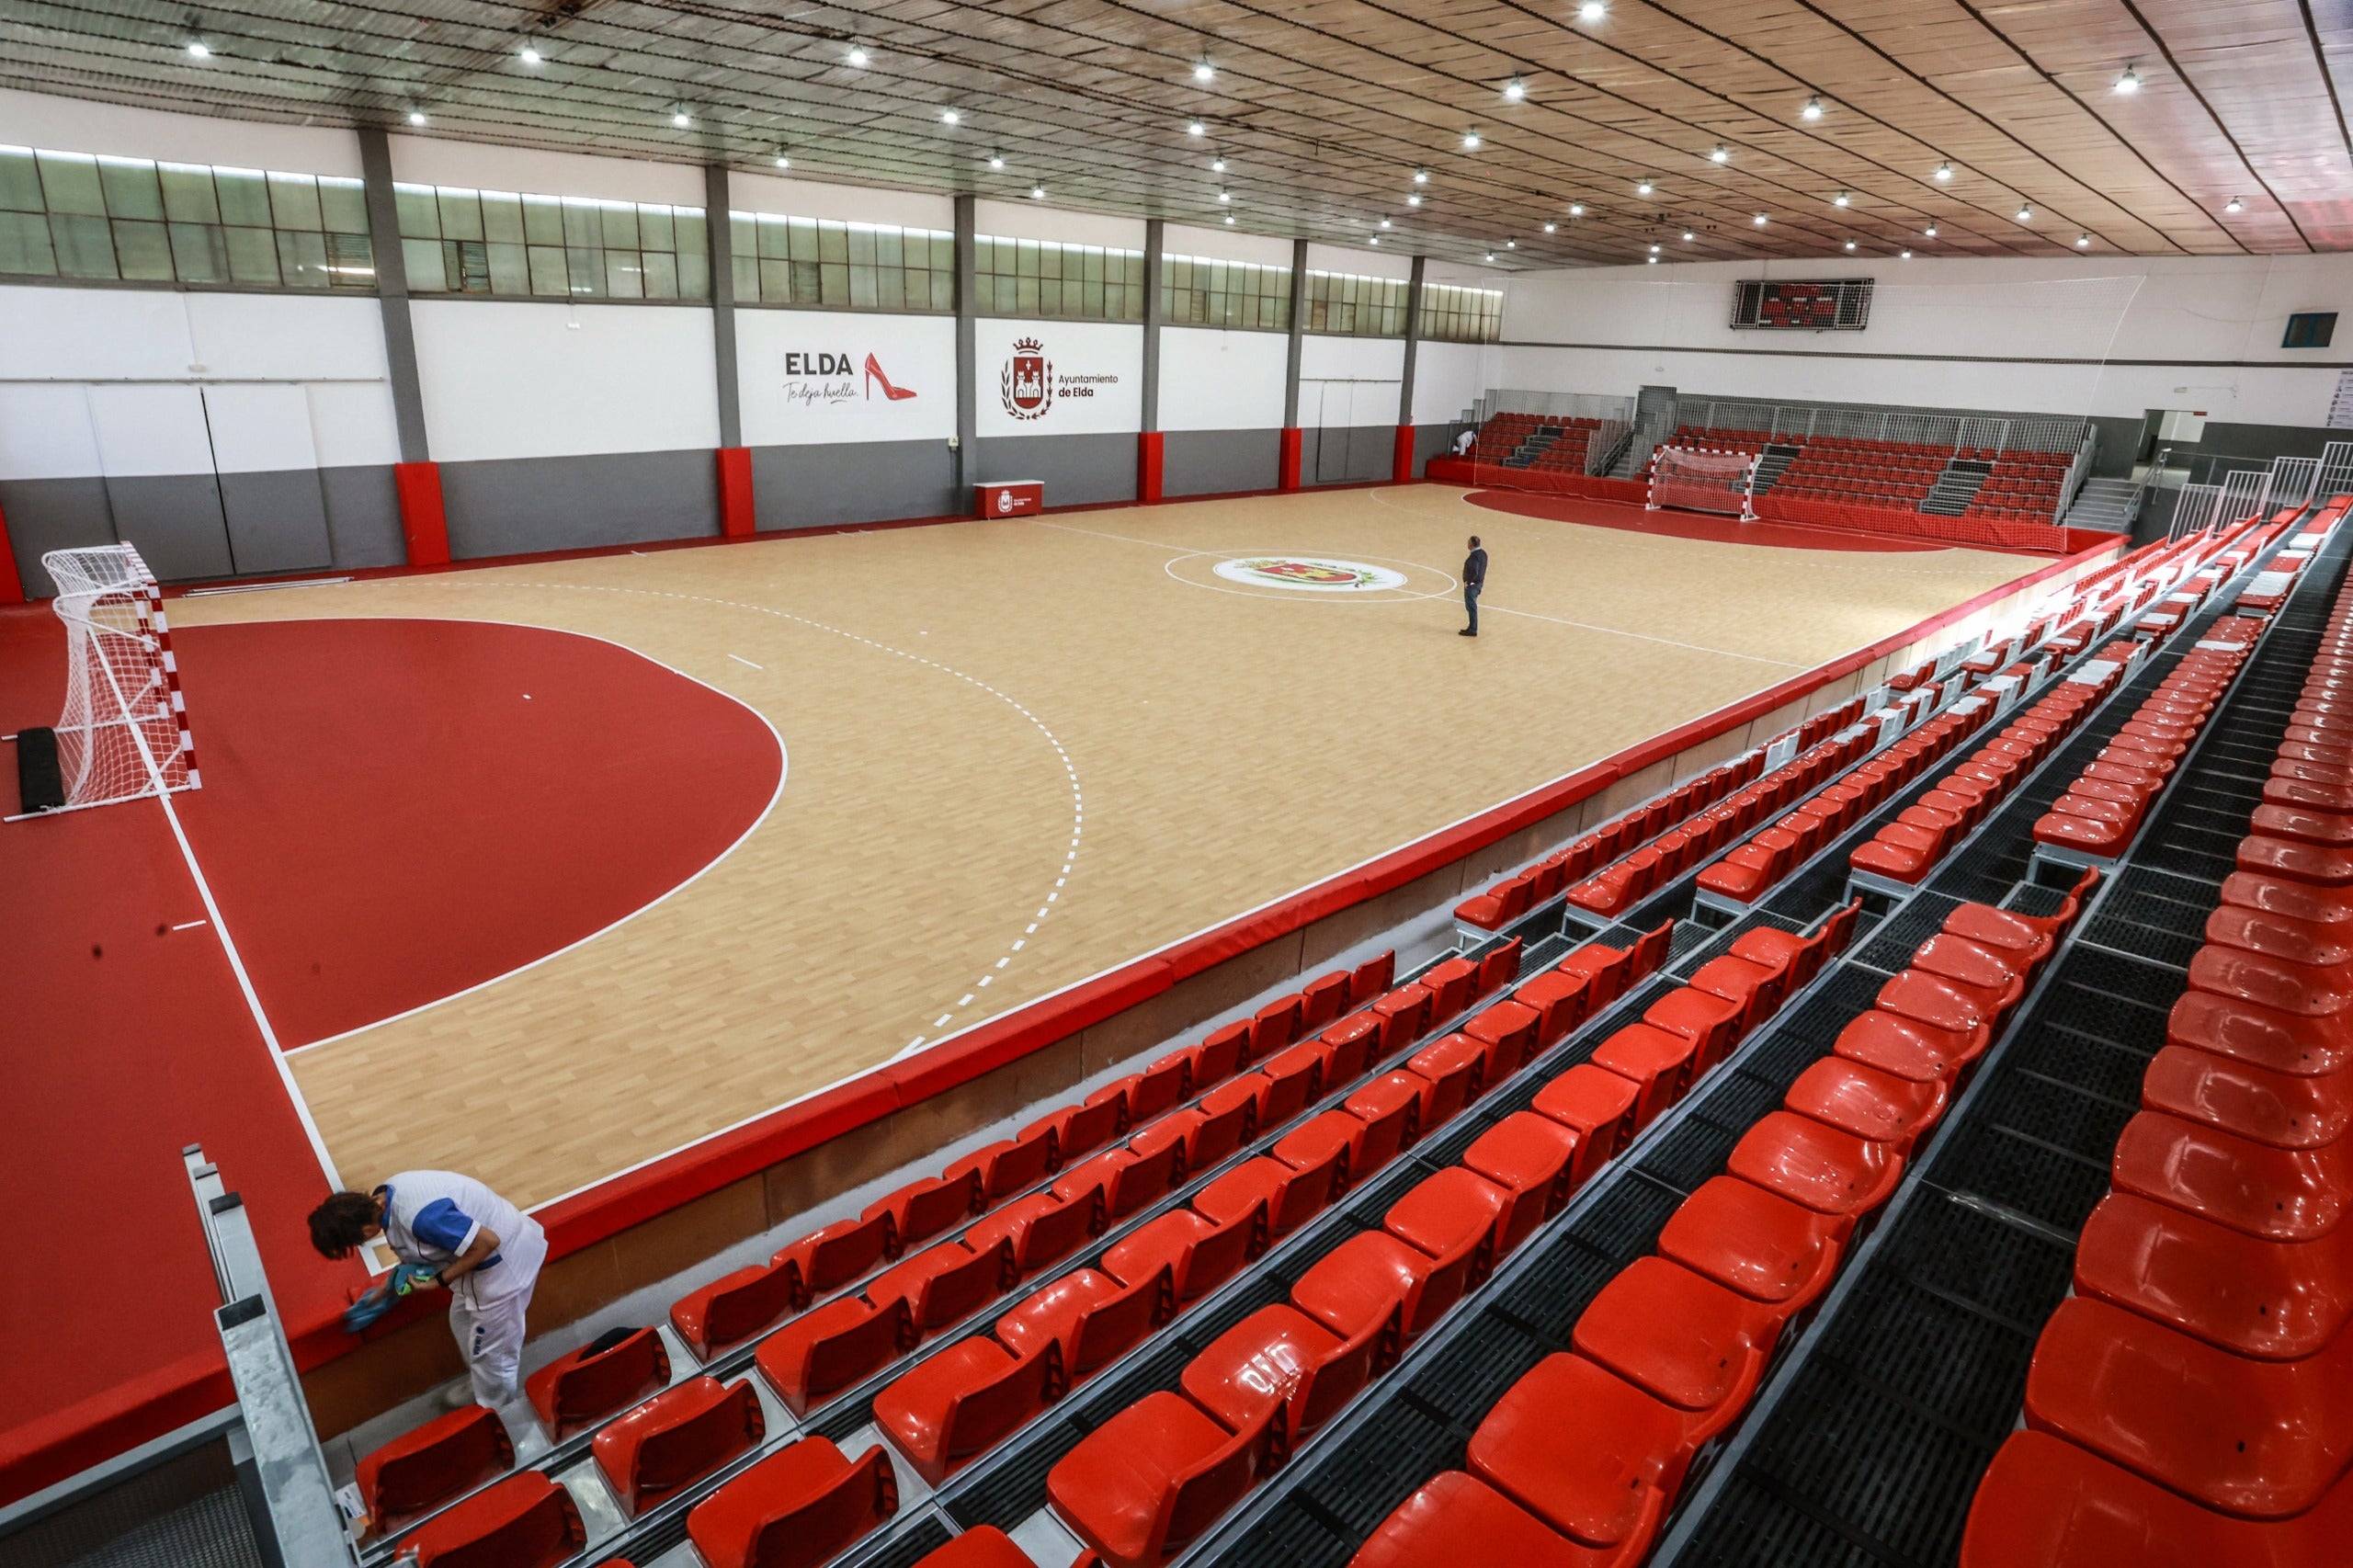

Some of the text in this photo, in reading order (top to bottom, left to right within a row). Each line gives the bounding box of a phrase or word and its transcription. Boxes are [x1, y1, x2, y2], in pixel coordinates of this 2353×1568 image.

[786, 353, 854, 375] ELDA
[1059, 373, 1119, 386] Ayuntamiento
[782, 381, 800, 403] Te
[799, 382, 823, 406] deja
[1058, 386, 1094, 397] de Elda
